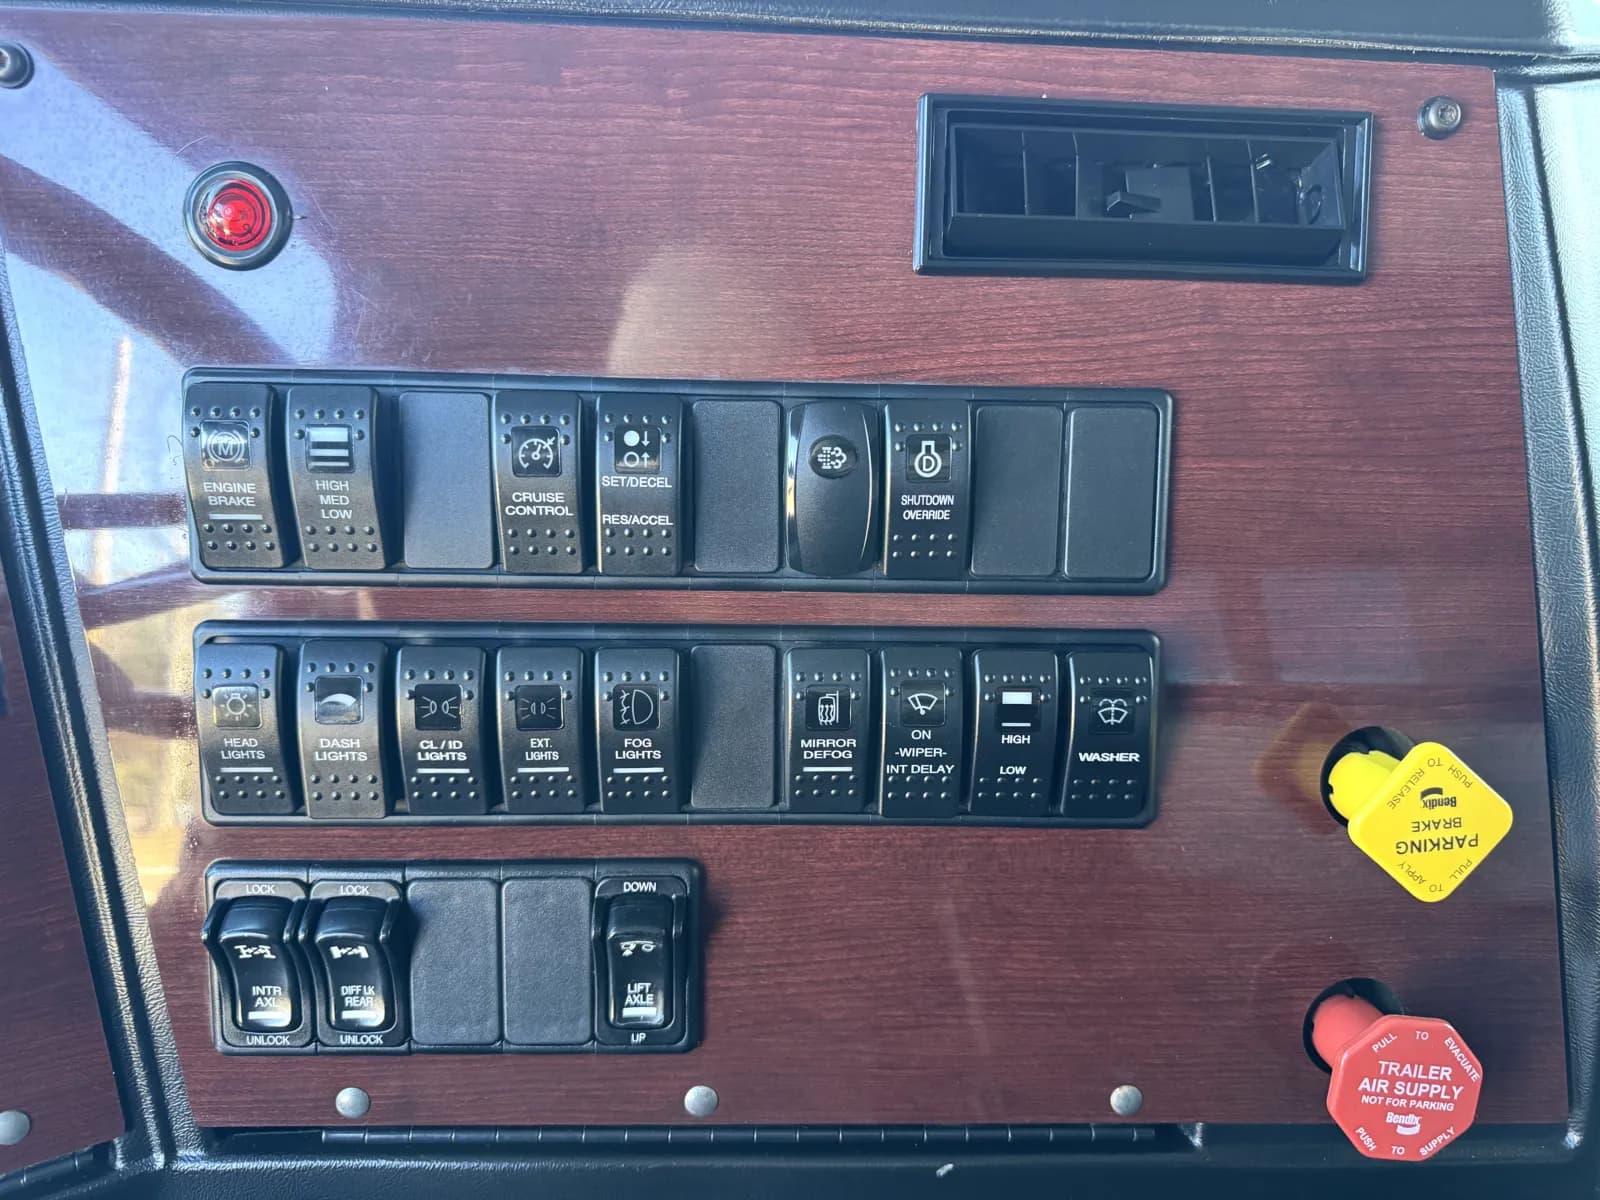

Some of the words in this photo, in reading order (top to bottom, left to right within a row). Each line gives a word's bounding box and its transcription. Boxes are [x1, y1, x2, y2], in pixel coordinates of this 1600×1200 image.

[315, 480, 349, 491] HIGH
[601, 476, 672, 488] SET/DECEL
[203, 482, 257, 494] ENGINE
[208, 496, 256, 507] BRAKE
[320, 495, 350, 505] MED
[512, 492, 565, 503] CRUISE
[901, 494, 954, 506] SHUTDOWN
[321, 509, 353, 520] LOW
[505, 506, 574, 516] CONTROL
[903, 509, 951, 520] OVERRIDE
[602, 515, 673, 526] RES/ACCEL
[911, 729, 932, 740] ON
[1001, 734, 1031, 745] HIGH
[223, 738, 258, 748] HEAD
[320, 738, 361, 749] DASH
[530, 738, 553, 748] EXT.
[624, 738, 653, 748] FOG
[800, 738, 857, 748] MIRROR
[221, 750, 266, 760] LIGHTS
[314, 751, 368, 762] LIGHTS
[417, 751, 467, 761] LIGHTS
[525, 750, 559, 761] LIGHTS
[615, 750, 662, 760] LIGHTS
[803, 750, 853, 759] DEFOG
[894, 748, 947, 758] -WIPER-
[1078, 752, 1140, 762] WASHER
[1427, 757, 1443, 768] TO
[886, 764, 908, 774] INT
[911, 764, 955, 774] DELAY
[1000, 766, 1027, 775] LOW
[1447, 764, 1473, 789] PUSH
[1386, 768, 1425, 810] RELEASE
[1422, 796, 1457, 810] Bendix
[1411, 817, 1462, 833] BRAKE
[1395, 833, 1479, 855] PARKING
[1398, 862, 1426, 885] APPLY
[1450, 858, 1473, 881] PULL
[246, 884, 276, 895] LOCK
[340, 885, 369, 896] LOCK
[623, 882, 657, 893] DOWN
[1428, 883, 1444, 893] TO
[252, 985, 282, 997] INTR
[341, 985, 362, 996] DIFF
[363, 985, 375, 996] LK
[627, 982, 652, 994] LIFT
[254, 997, 280, 1008] AXL
[344, 996, 374, 1007] REAR
[624, 994, 654, 1006] AXLE
[246, 1035, 290, 1046] UNLOCK
[340, 1034, 384, 1045] UNLOCK
[631, 1032, 646, 1044] UP
[1371, 1032, 1398, 1053] PULL
[1415, 1030, 1429, 1041] TO
[1443, 1037, 1480, 1083] EVACUATE
[1378, 1060, 1453, 1081] TRAILER
[1358, 1078, 1390, 1094] AIR
[1393, 1083, 1464, 1100] SUPPLY
[1361, 1095, 1385, 1105] NOT
[1385, 1098, 1407, 1108] FOR
[1409, 1100, 1455, 1111] PARKING
[1386, 1112, 1422, 1125] Bendix
[1355, 1127, 1377, 1152] PUSH
[1391, 1145, 1405, 1155] TO
[1419, 1126, 1456, 1157] SUPPLY
